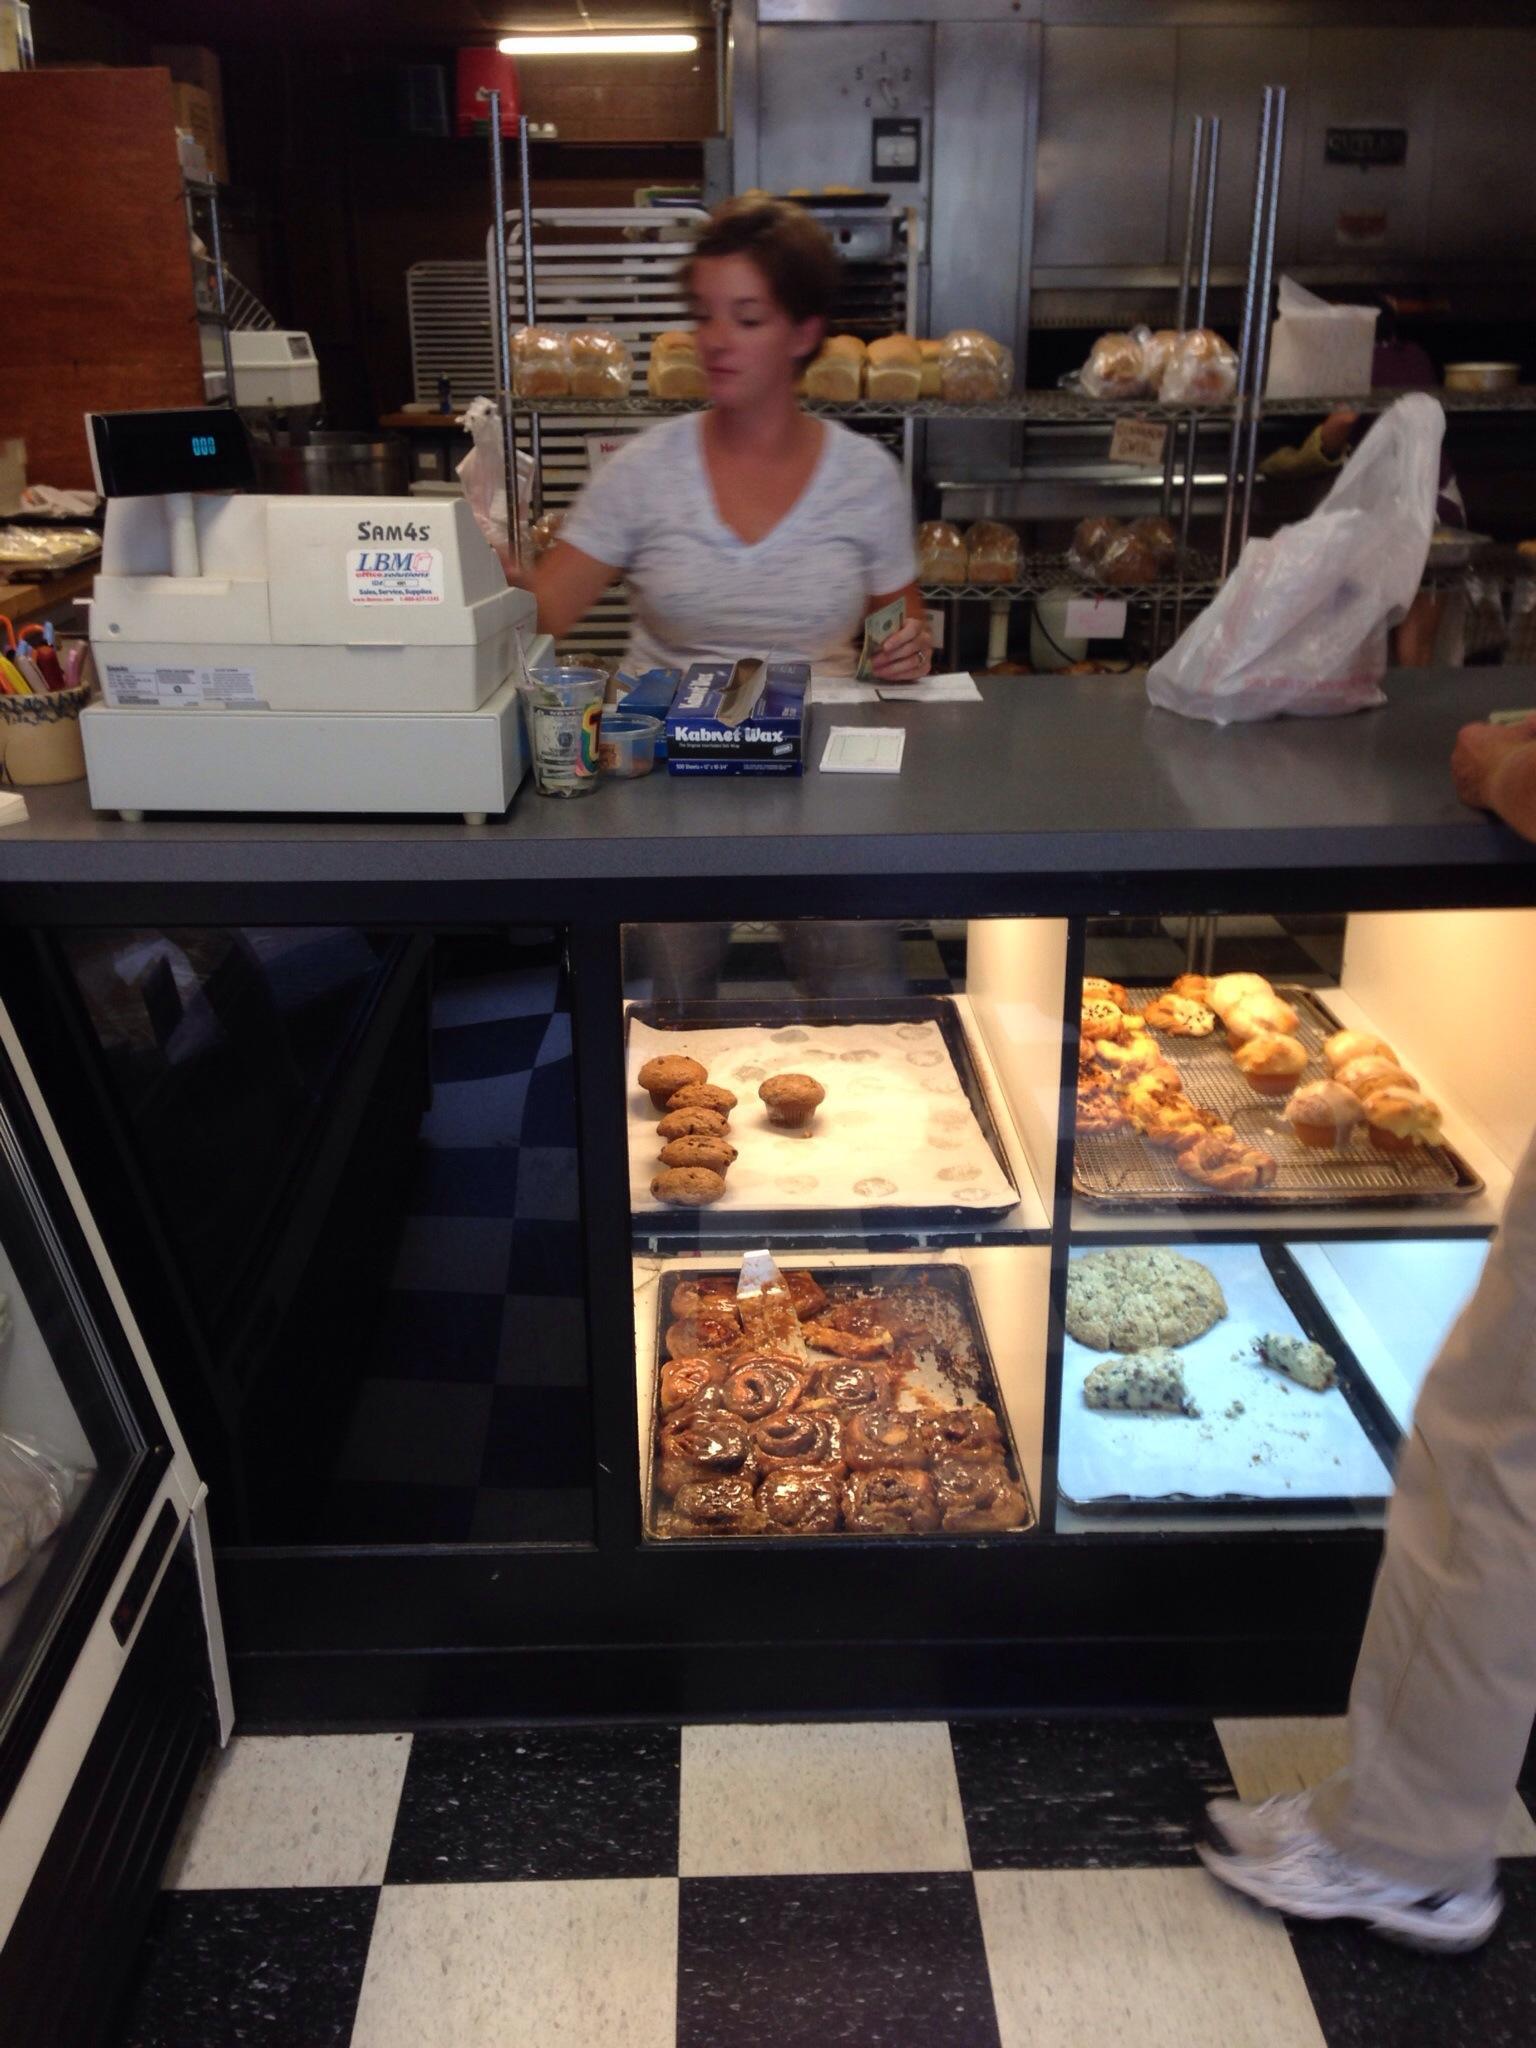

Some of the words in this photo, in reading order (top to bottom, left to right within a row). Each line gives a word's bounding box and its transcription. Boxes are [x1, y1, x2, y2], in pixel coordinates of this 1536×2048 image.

[355, 552, 414, 571] LBM
[405, 588, 432, 596] Supplies
[674, 726, 741, 742] Kabnet
[744, 727, 784, 743] Wax
